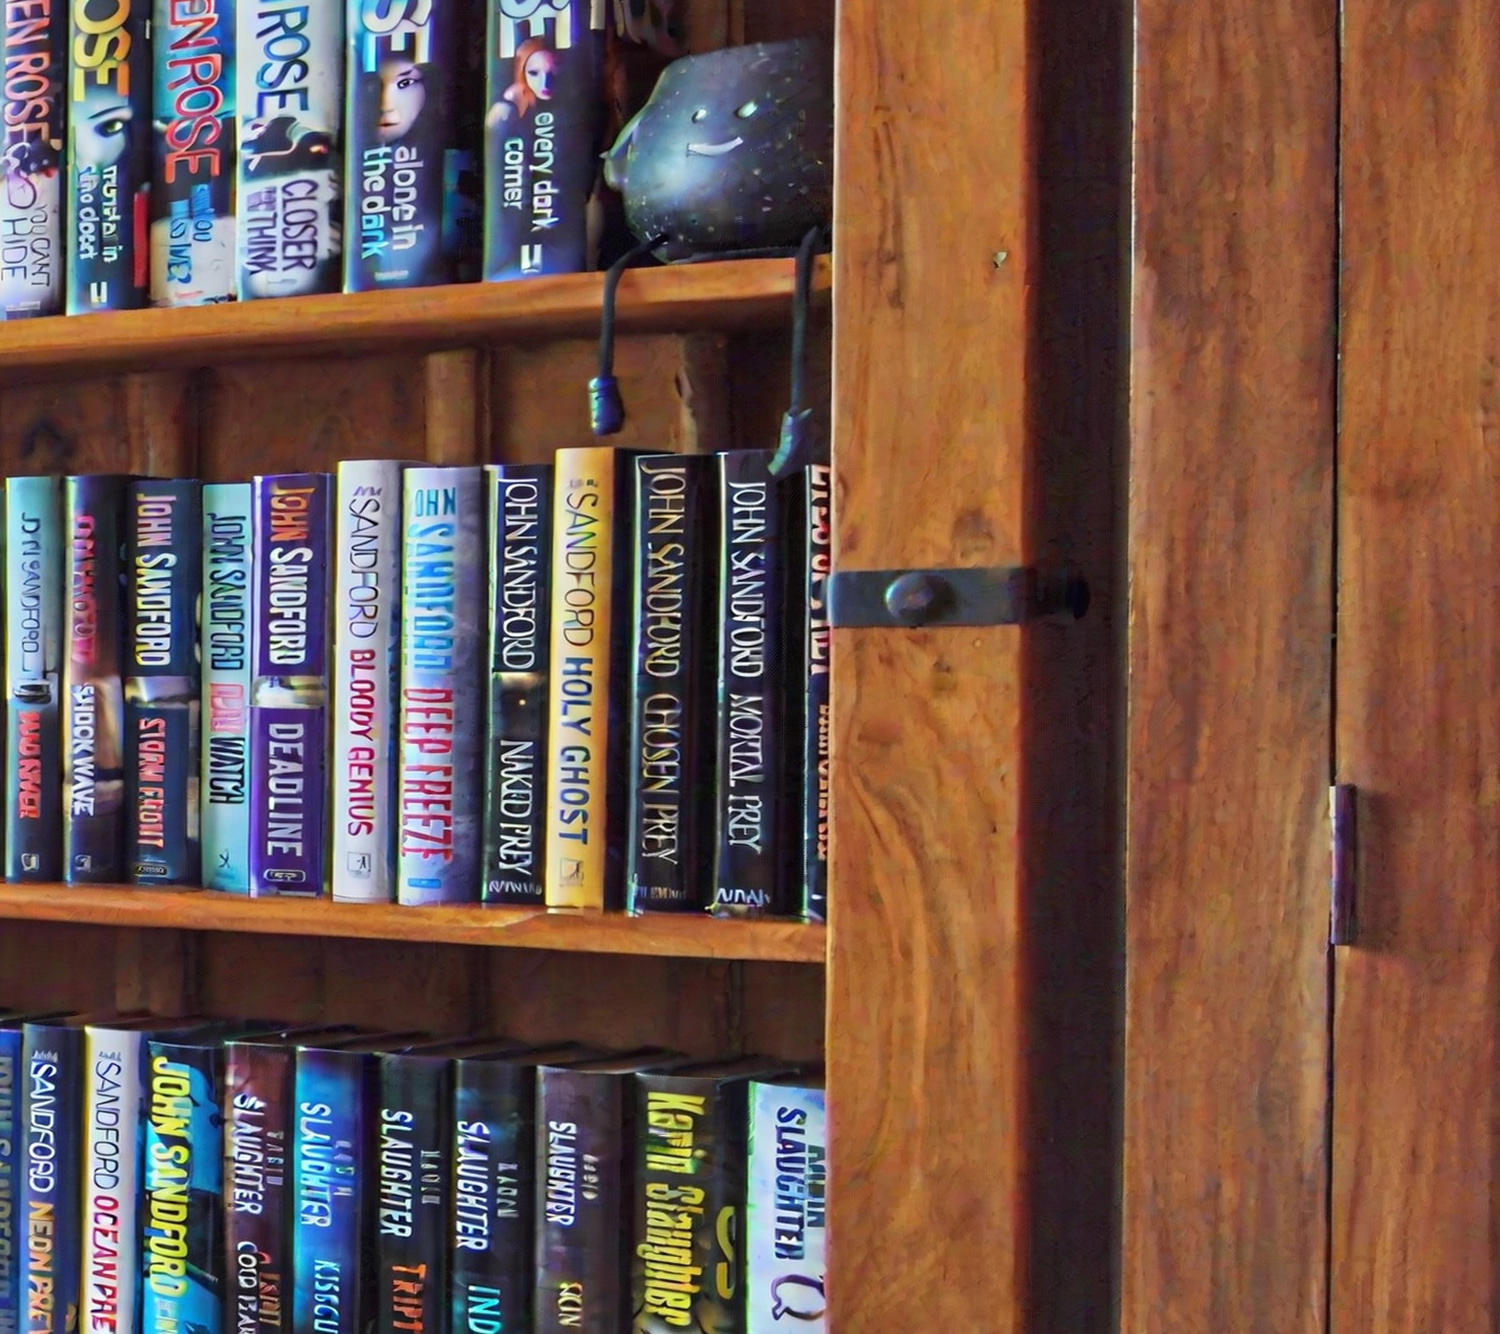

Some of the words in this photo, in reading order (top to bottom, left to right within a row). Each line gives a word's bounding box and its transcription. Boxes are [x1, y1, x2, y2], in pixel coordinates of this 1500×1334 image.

[4, 51, 52, 141] ROSE
[256, 6, 309, 116] ROSE
[165, 54, 222, 183] ROSE
[364, 146, 387, 193] the
[392, 146, 422, 220] alone
[1, 218, 27, 281] HIDE
[282, 179, 318, 270] CLOSER
[362, 196, 387, 259] dark
[392, 224, 423, 250] in
[135, 493, 176, 546] JOHN
[269, 486, 312, 542] JOHN
[499, 477, 538, 540] JOHN
[642, 466, 685, 533] JOHN
[728, 482, 765, 543] JOHN
[135, 553, 178, 666] SANDFORD
[269, 547, 312, 664] SANDFORD
[349, 498, 379, 638] SANDFORD
[501, 546, 537, 668] SANDFORD
[563, 493, 599, 646] SANDFORD
[644, 543, 685, 677] SANDFORD
[728, 551, 765, 677] SANDFORD
[350, 649, 376, 740] BLOODY
[402, 687, 453, 754] DEEP
[560, 657, 592, 736] HOLY
[729, 693, 763, 787] MORTAL
[72, 761, 95, 816] WAVE
[500, 740, 533, 817] NAKED
[643, 693, 682, 794] CHOSEN
[267, 723, 304, 857] DEADLINE
[348, 747, 375, 836] GENIUS
[402, 765, 453, 861] FREEZE
[559, 745, 589, 845] GHOST
[642, 802, 678, 864] PREY
[728, 794, 763, 856] PREY
[499, 823, 532, 875] PREY
[29, 1063, 57, 1193] SANDFORD
[93, 1061, 120, 1189] SANDFORD
[151, 1056, 190, 1137] JOHN
[647, 1092, 705, 1174] Karin
[233, 1094, 267, 1214] SLAUGHTER
[380, 1108, 412, 1237] SLAUGHTER
[456, 1121, 490, 1251] SLAUGHTER
[774, 1107, 806, 1260] SLAUGHTER
[28, 1201, 53, 1271] NEON
[92, 1195, 118, 1279] OCEAN
[149, 1144, 188, 1297] SANDFORD
[636, 1183, 703, 1327] Slaughter
